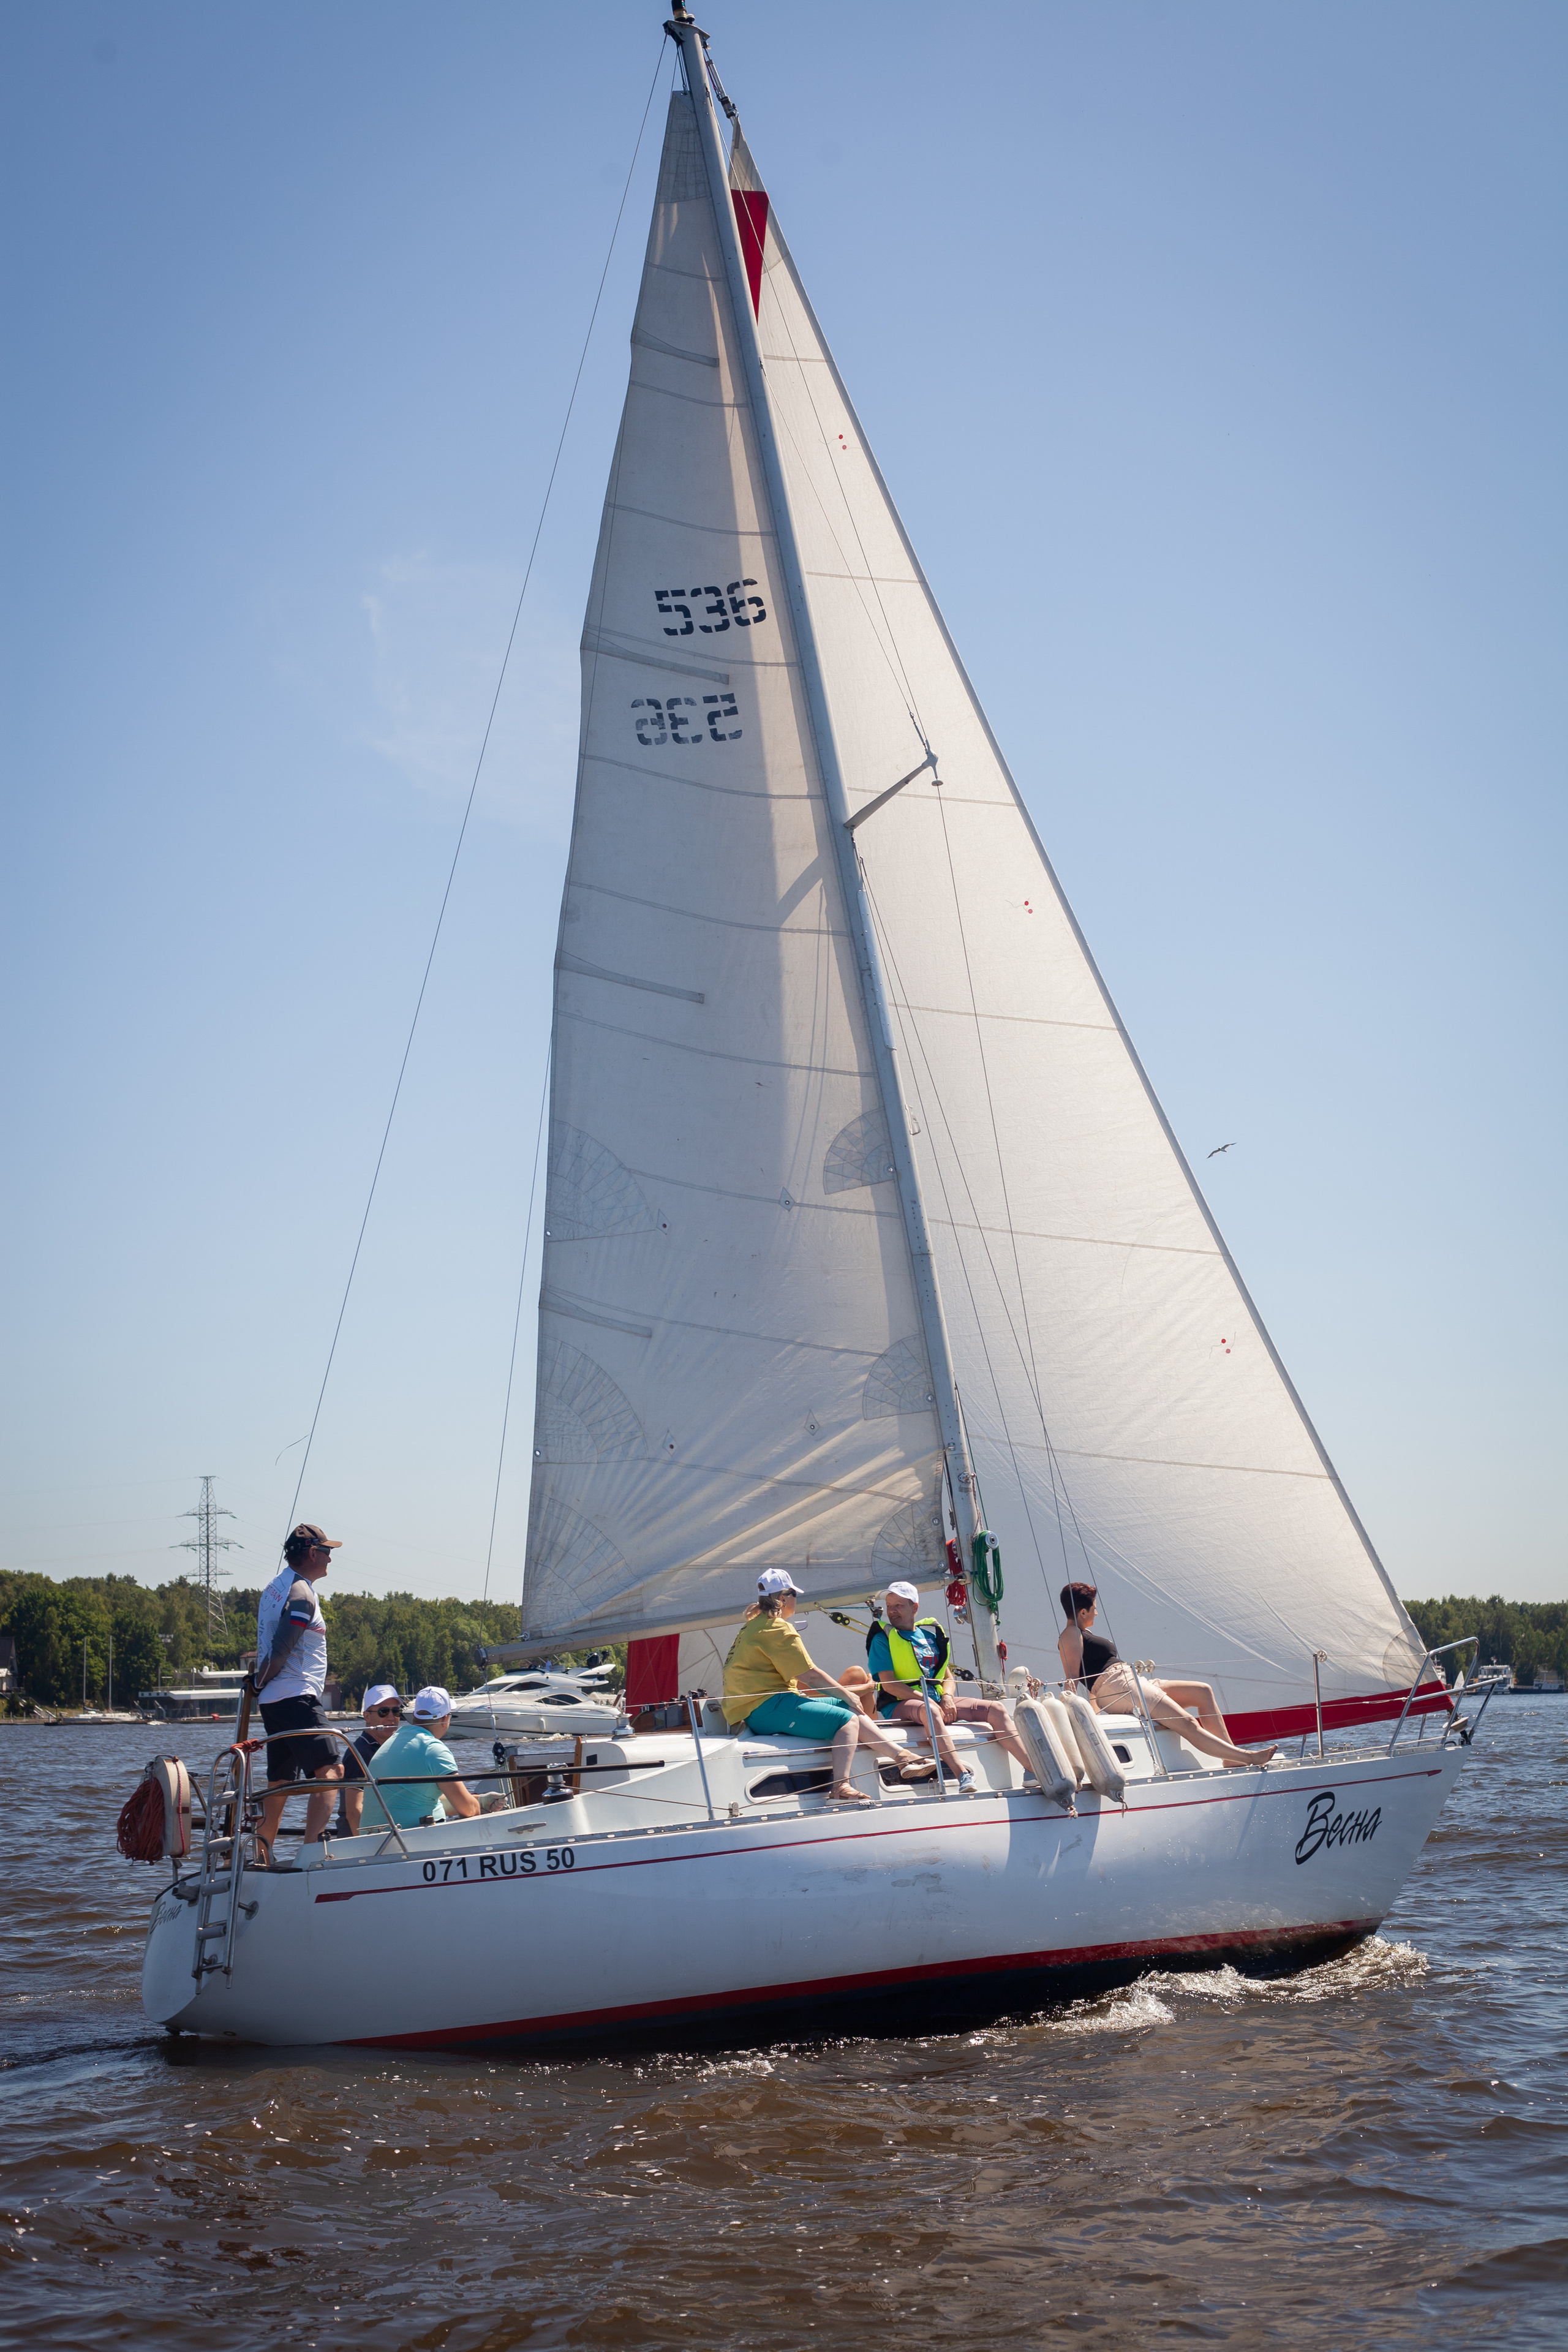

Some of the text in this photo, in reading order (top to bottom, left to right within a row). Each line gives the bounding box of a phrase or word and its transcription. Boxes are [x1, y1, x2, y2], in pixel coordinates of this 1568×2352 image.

[655, 578, 766, 636] 536
[1295, 1792, 1382, 1865] Весна
[423, 1847, 575, 1882] 071 RUS 50
